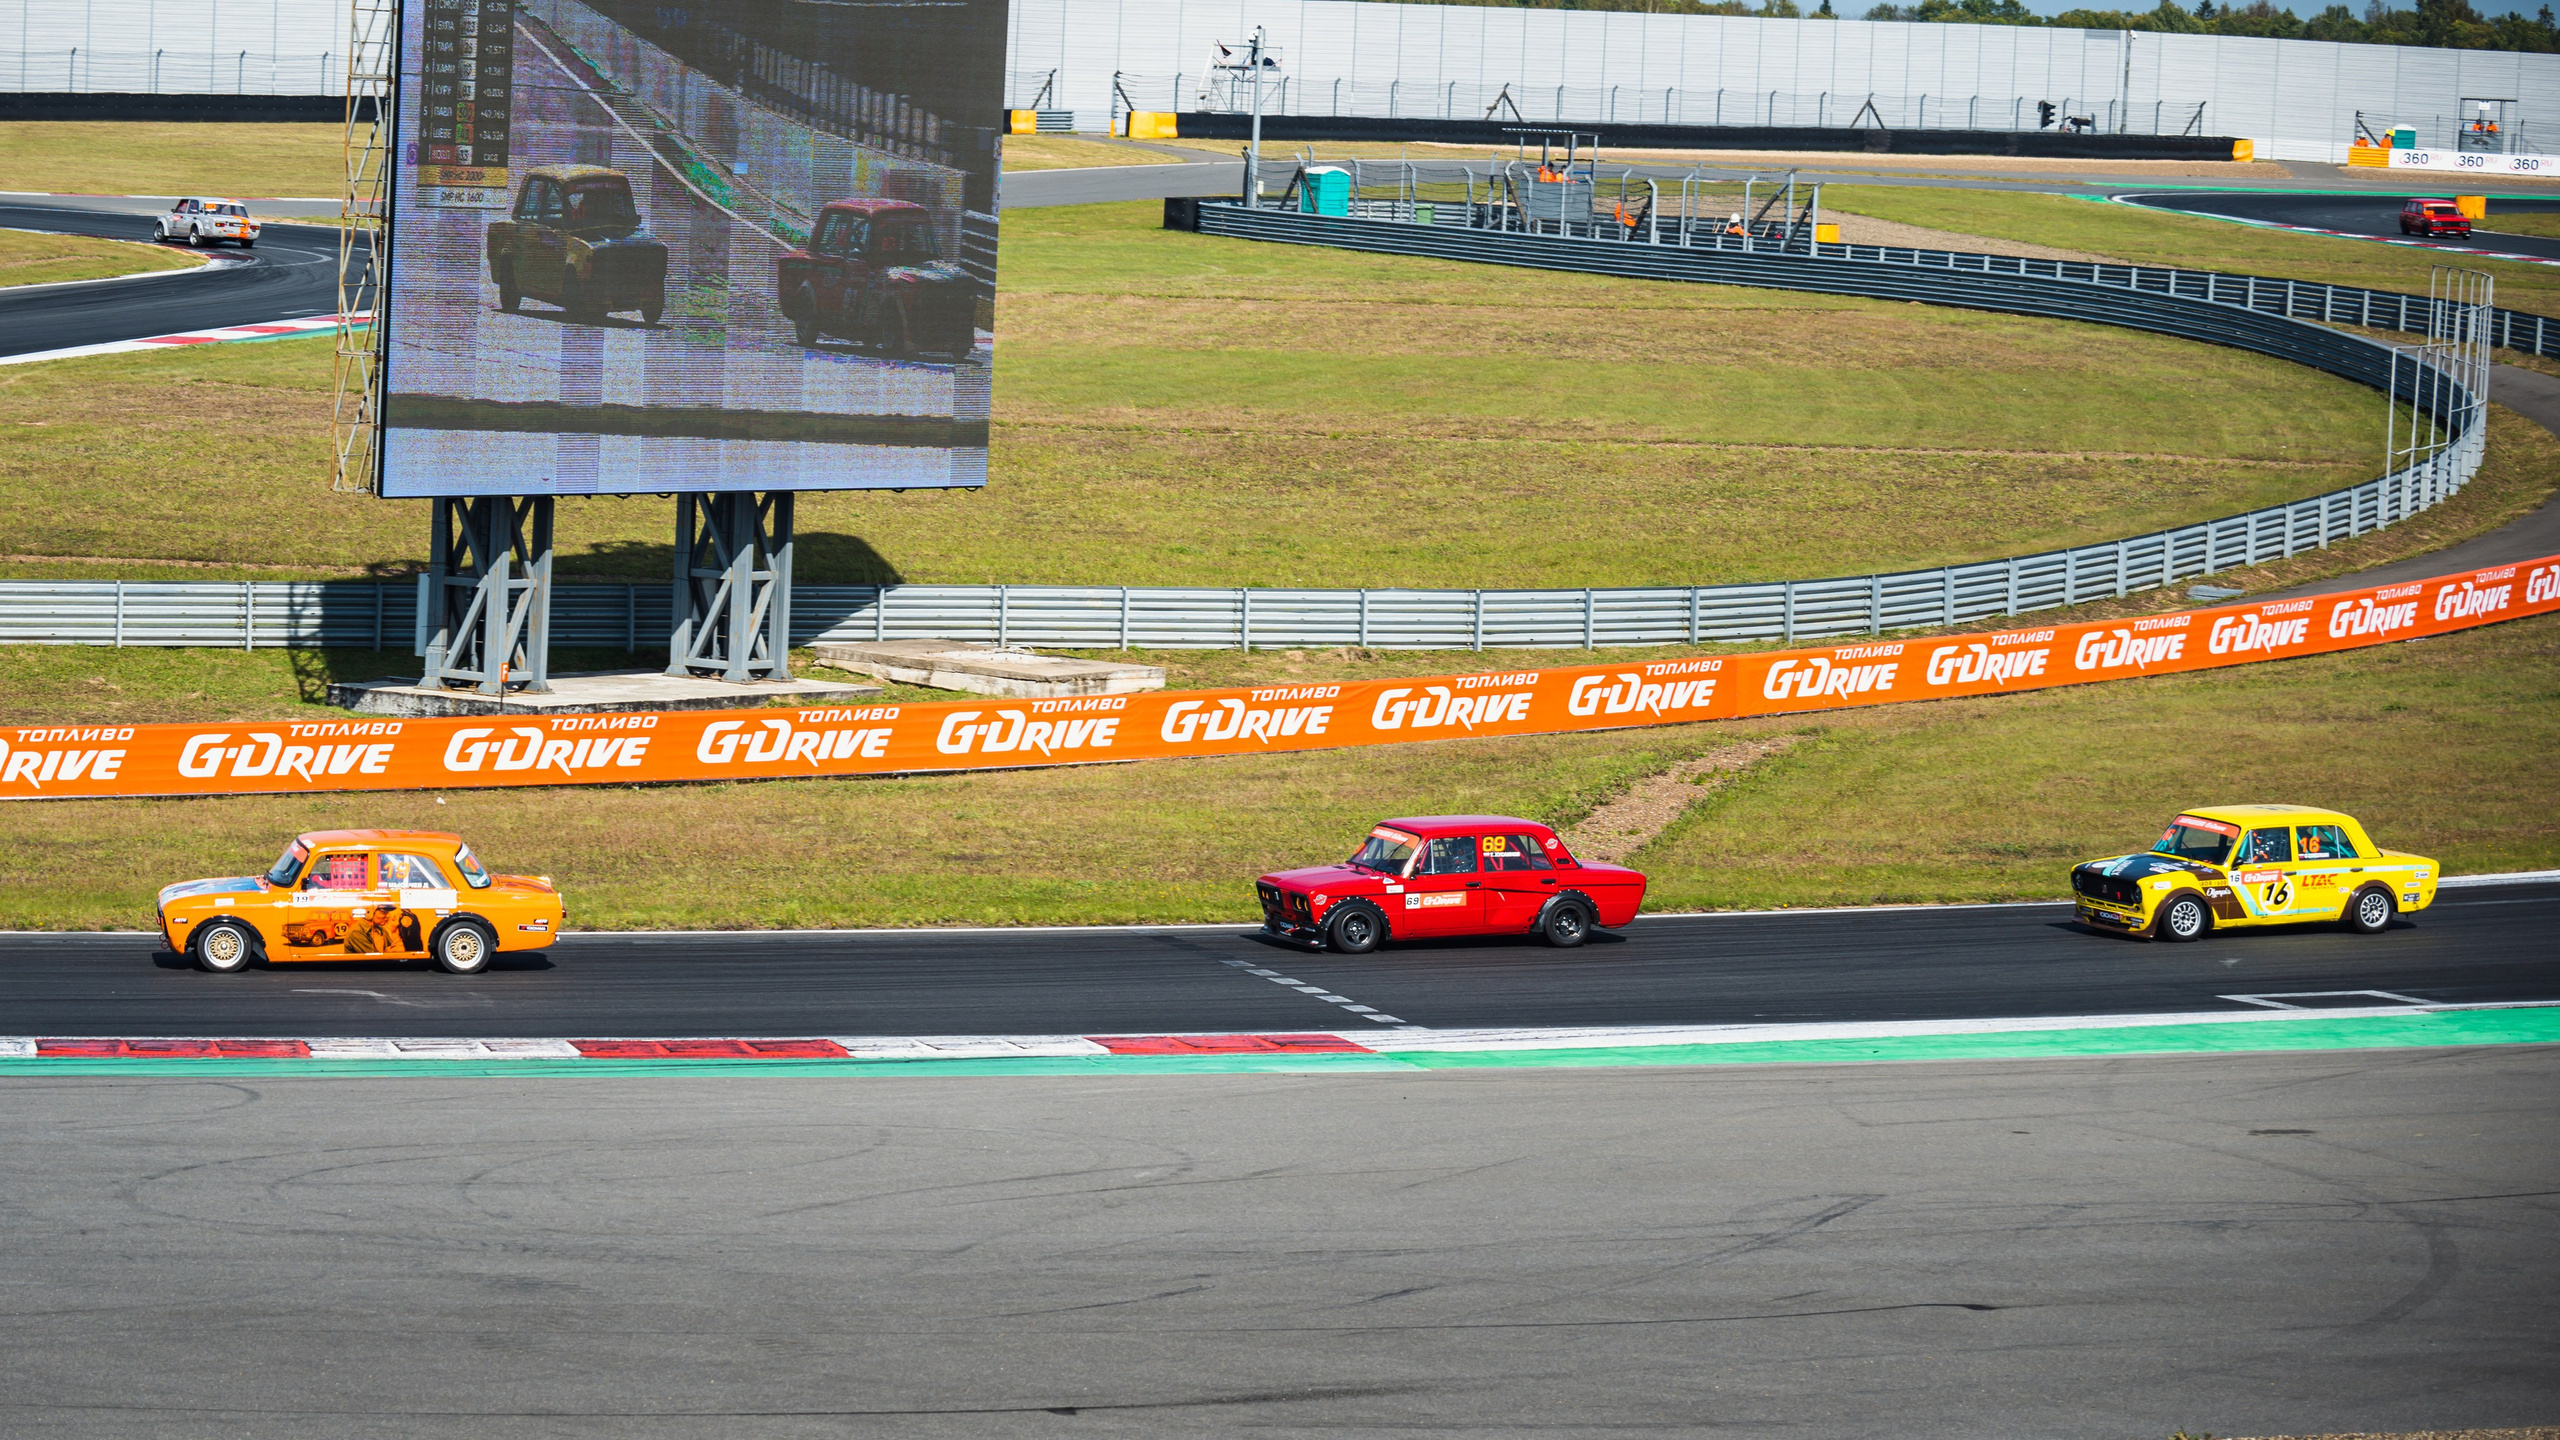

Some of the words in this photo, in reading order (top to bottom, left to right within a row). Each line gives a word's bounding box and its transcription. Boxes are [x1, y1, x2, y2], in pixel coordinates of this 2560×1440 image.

[2404, 153, 2429, 164] 360
[2458, 156, 2484, 167] 360
[2513, 158, 2539, 170] 360
[2475, 567, 2516, 583] ТОПЛИВО
[2376, 584, 2422, 601] ТОПЛИВО
[2262, 600, 2314, 616] ТОПЛИВО
[2134, 615, 2191, 632] ТОПЛИВО
[1992, 630, 2055, 646] ТОПЛИВО
[1835, 644, 1904, 661] ТОПЛИВО
[1646, 660, 1722, 676] ТОПЛИВО
[1456, 673, 1538, 689] ТОПЛИВО
[1251, 686, 1340, 701] ТОПЛИВО
[1032, 698, 1127, 713] ТОПЛИВО
[799, 708, 900, 722] ТОПЛИВО
[290, 723, 403, 736] ТОПЛИВО
[551, 717, 658, 730] ТОПЛИВО
[17, 728, 134, 742] ТОПЛИВО
[0, 738, 127, 789] RIVE
[1482, 836, 1506, 852] 69
[2298, 836, 2321, 853] 16
[383, 861, 410, 879] 19
[2230, 874, 2241, 883] 16
[2301, 873, 2339, 887] LTAC
[1406, 897, 1420, 905] 69
[2266, 883, 2289, 905] 16
[335, 925, 347, 933] 19
